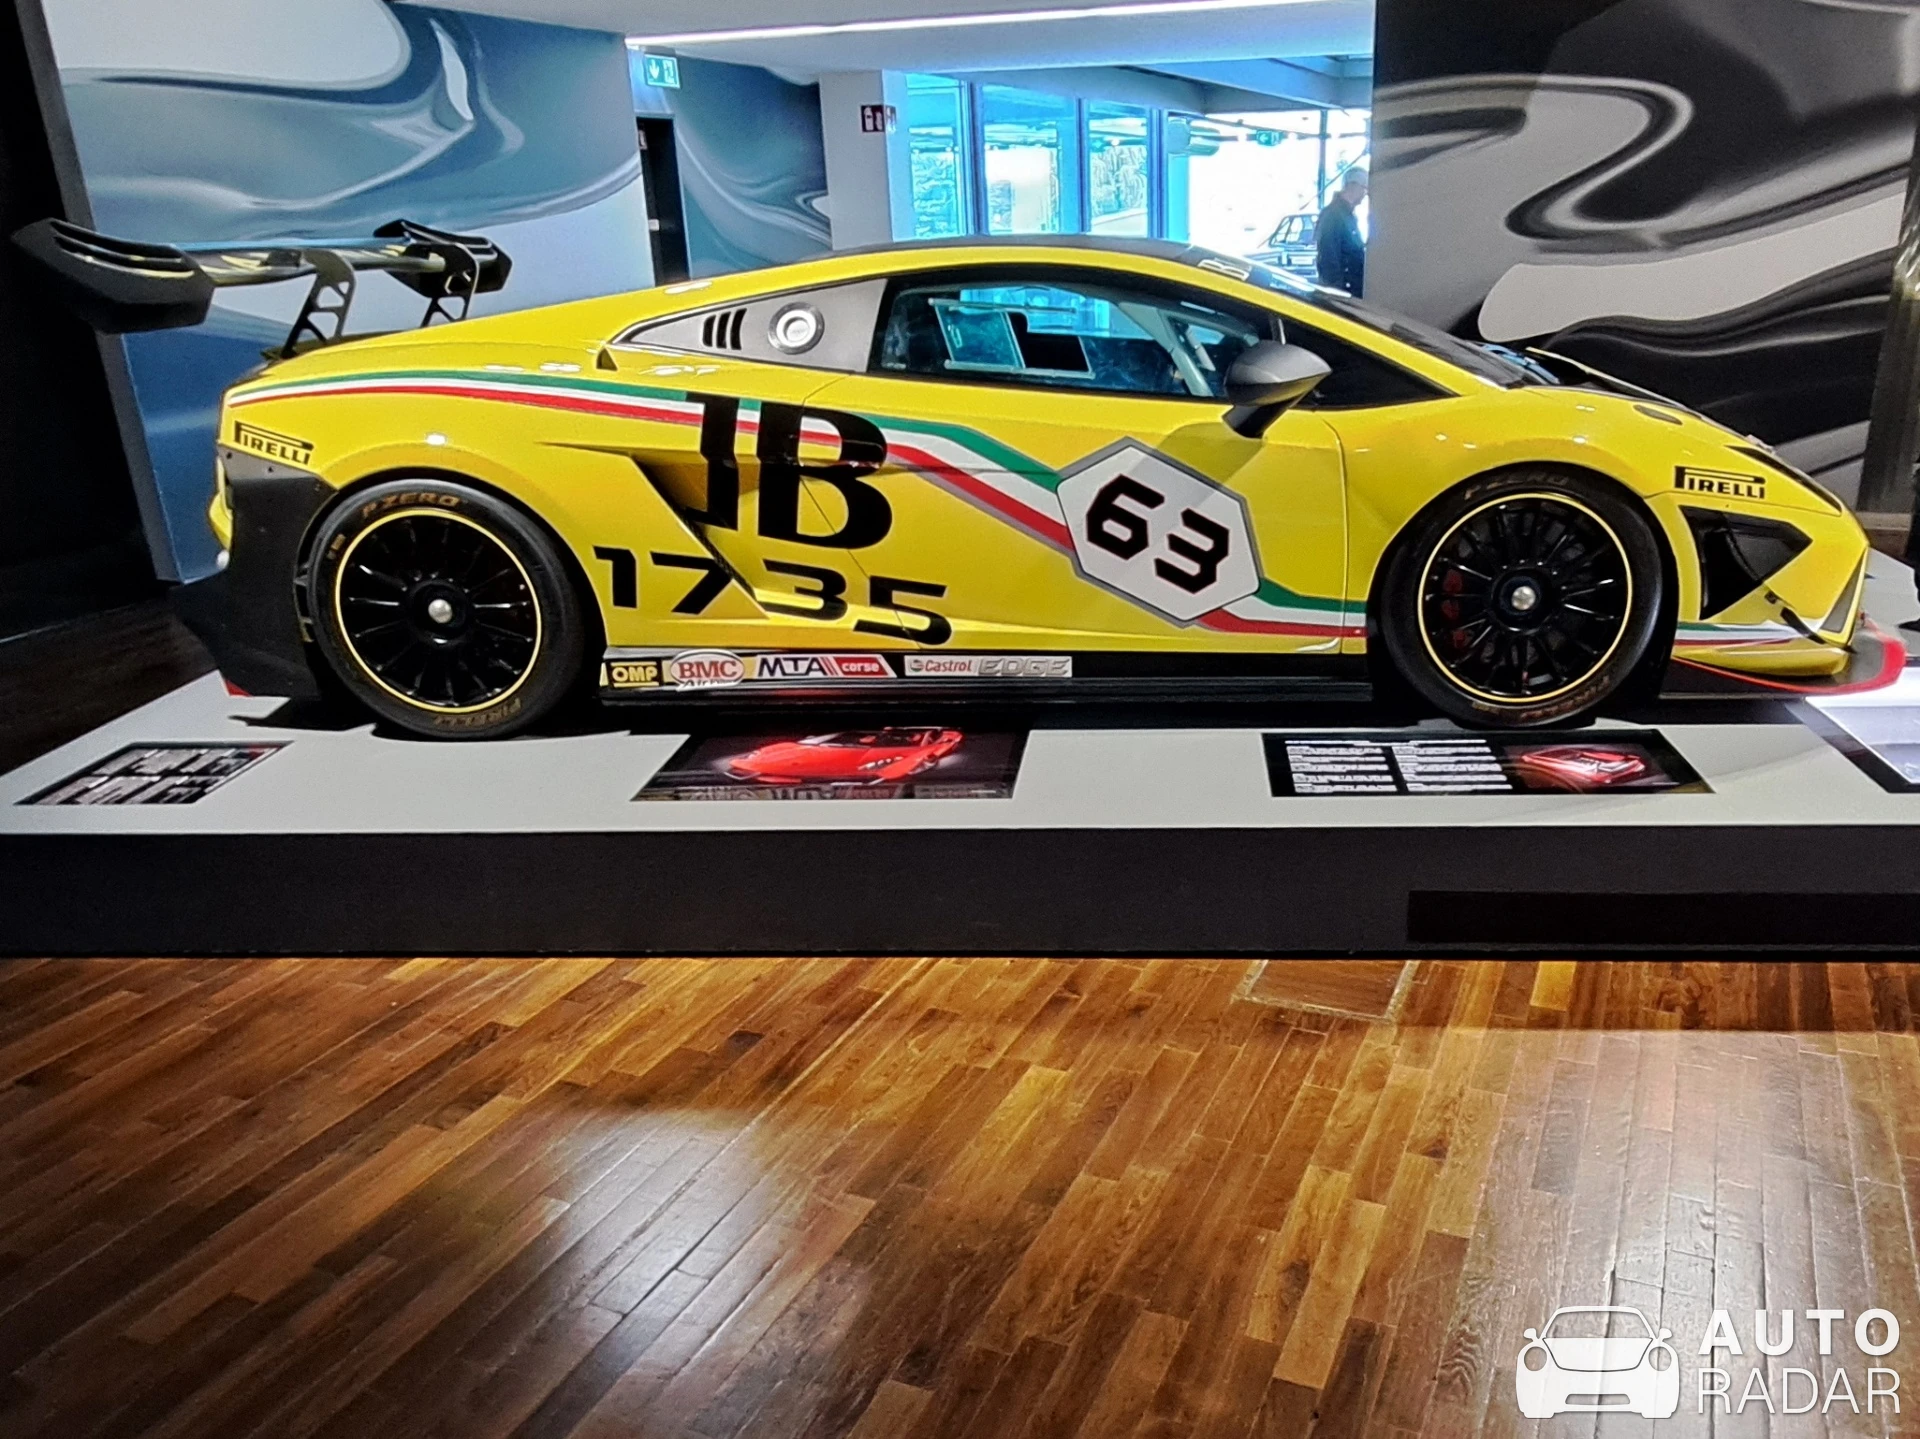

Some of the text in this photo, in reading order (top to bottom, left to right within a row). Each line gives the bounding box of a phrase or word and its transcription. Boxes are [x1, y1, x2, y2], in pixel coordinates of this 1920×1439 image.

[234, 420, 315, 466] PIRELLI
[1674, 465, 1766, 499] PIRELLI
[1086, 473, 1230, 594] 63
[592, 545, 953, 645] 1735
[612, 666, 658, 682] OMP
[678, 660, 738, 679] BMC
[758, 657, 880, 677] MTA corse
[925, 657, 1071, 677] Castrol EDGE
